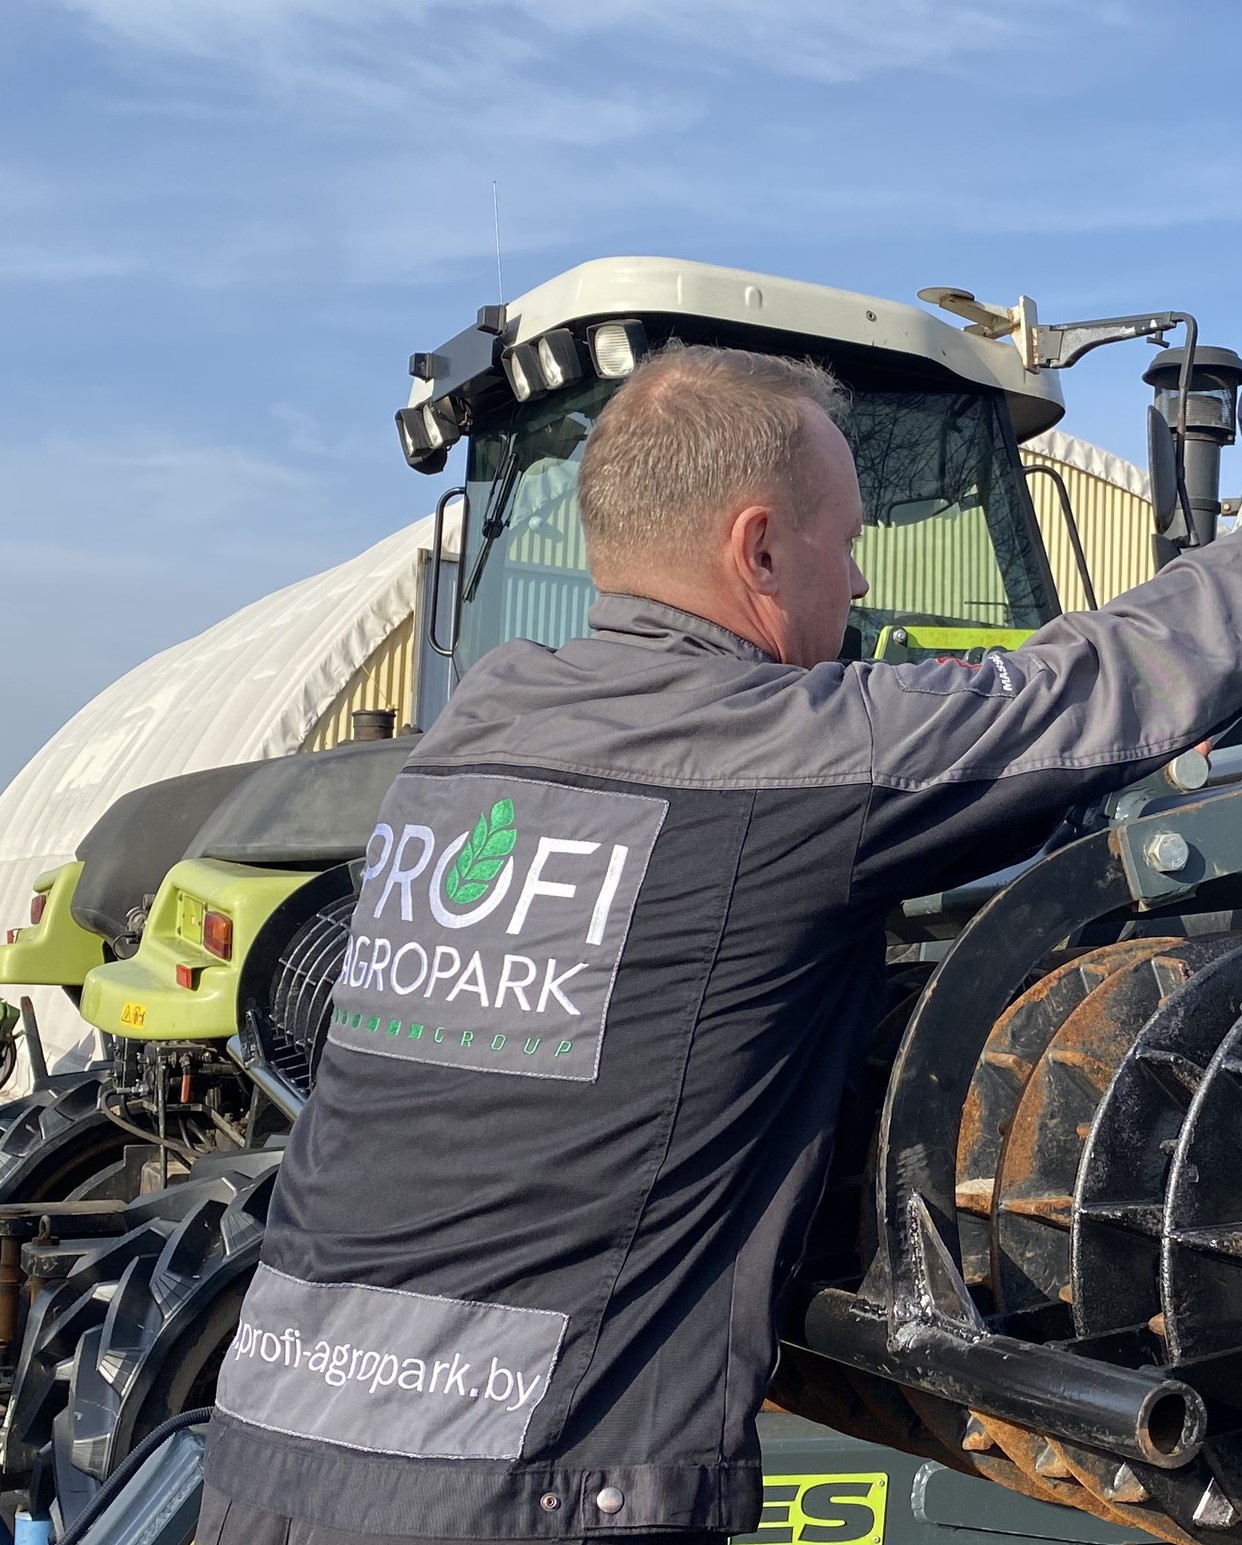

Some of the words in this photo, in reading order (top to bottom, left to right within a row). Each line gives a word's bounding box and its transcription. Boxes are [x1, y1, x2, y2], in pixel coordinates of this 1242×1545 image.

[353, 823, 629, 946] PROFI
[337, 935, 590, 1016] AGROPARK
[434, 1027, 572, 1057] GROUP
[232, 1318, 541, 1412] .profi-agropark.by
